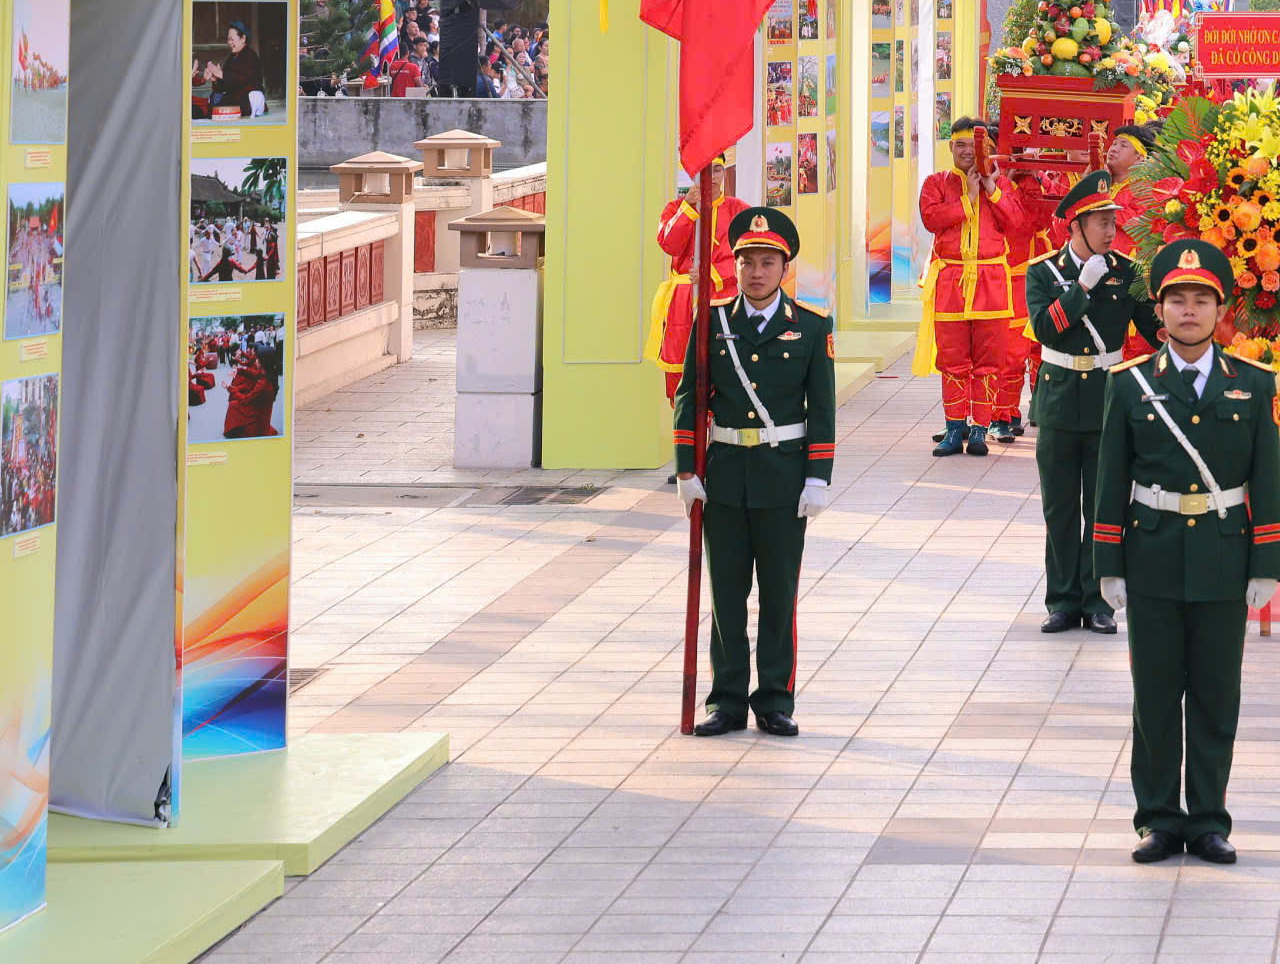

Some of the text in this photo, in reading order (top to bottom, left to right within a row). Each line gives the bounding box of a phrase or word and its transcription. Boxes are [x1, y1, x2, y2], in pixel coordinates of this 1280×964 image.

[1203, 26, 1219, 44] ĐỜI
[1221, 26, 1236, 44] ĐỜI
[1210, 47, 1225, 64] ĐÃ
[1226, 47, 1240, 64] CÓ
[1242, 47, 1270, 64] CÔNG
